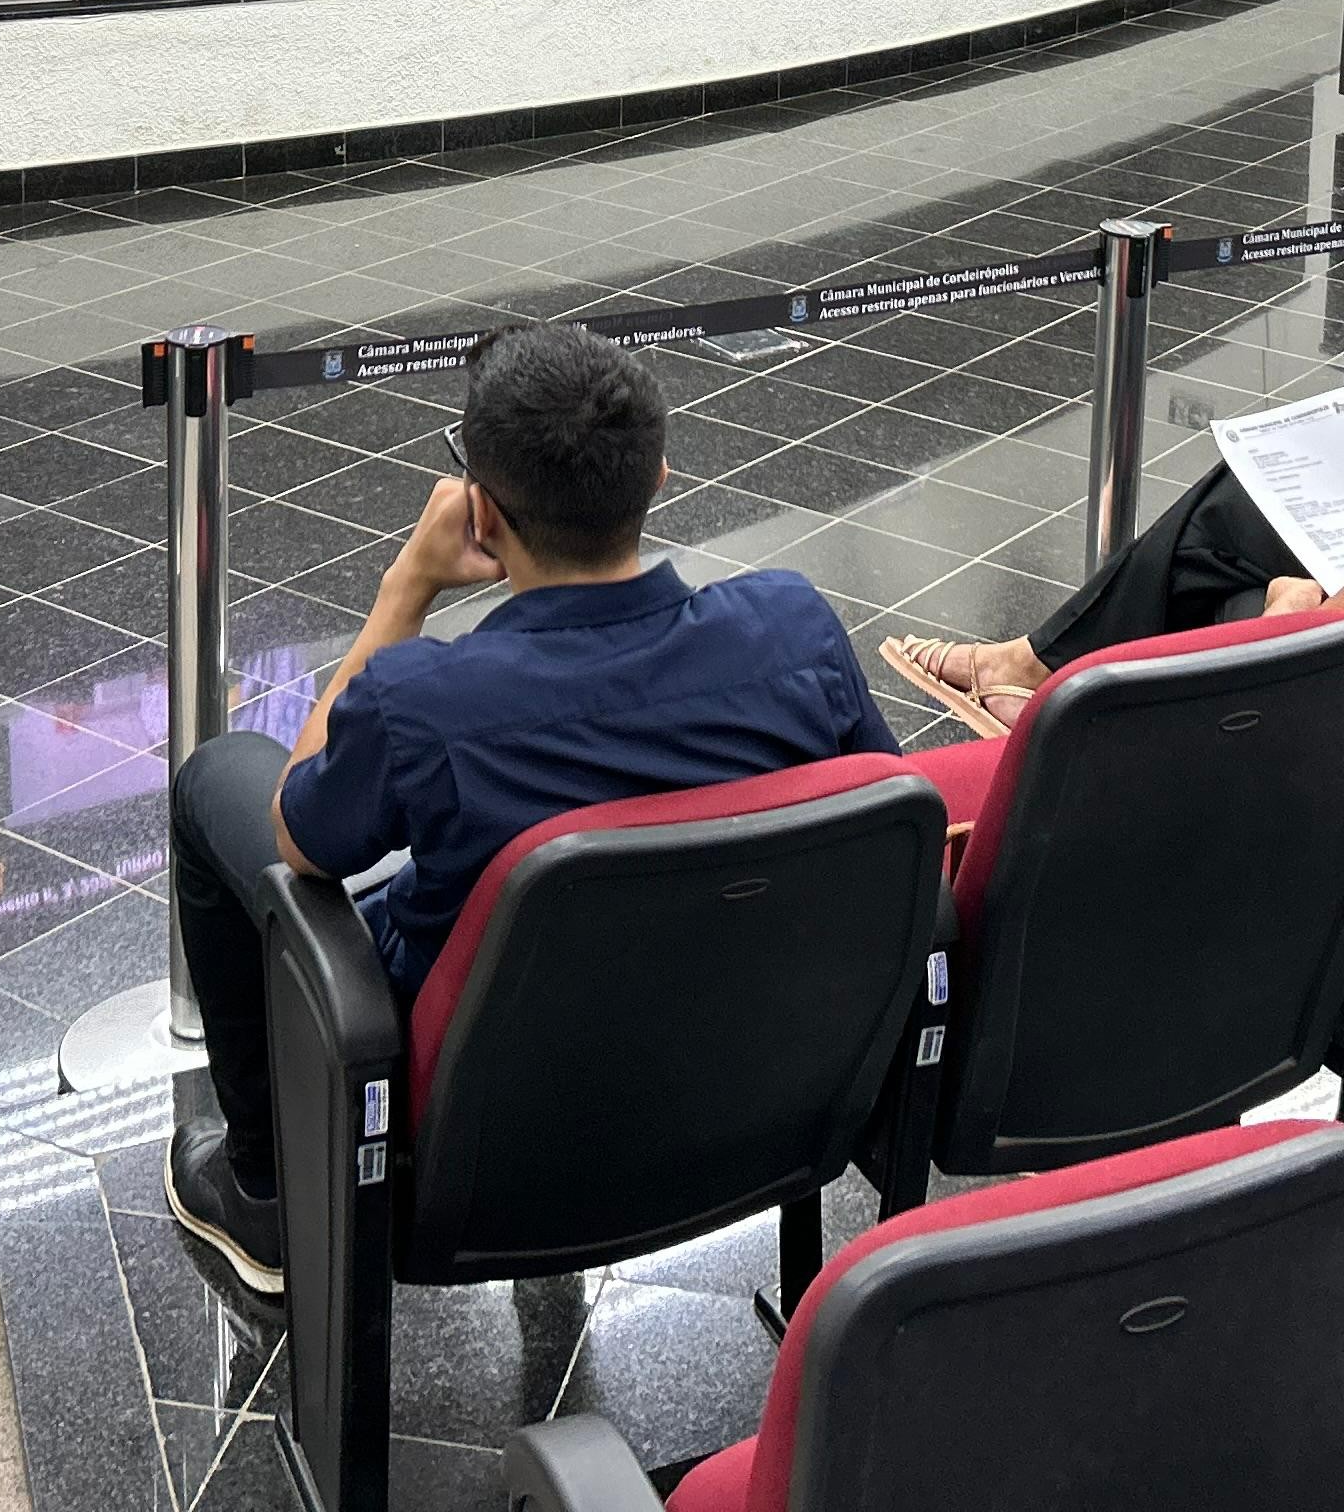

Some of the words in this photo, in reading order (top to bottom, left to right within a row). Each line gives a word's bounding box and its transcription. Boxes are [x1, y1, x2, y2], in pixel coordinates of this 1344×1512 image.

[1243, 232, 1279, 245] Câmara
[1282, 224, 1328, 240] Municipal
[1330, 222, 1342, 232] de
[1241, 248, 1275, 261] Acesso
[1276, 241, 1312, 257] restrito
[820, 288, 864, 302] Câmara
[867, 277, 923, 296] Municipal
[926, 275, 940, 288] de
[943, 263, 1019, 285] Cordeirópolis
[819, 305, 858, 320] Acesso
[861, 297, 905, 314] restrito
[908, 291, 948, 311] apenas
[950, 287, 976, 304] para
[978, 275, 1049, 296] funcionários
[1051, 275, 1057, 285] e
[358, 344, 410, 358] Câmara
[412, 333, 478, 353] Municipal
[623, 336, 631, 345] e
[357, 361, 404, 377] Acesso
[406, 355, 456, 372] restrito
